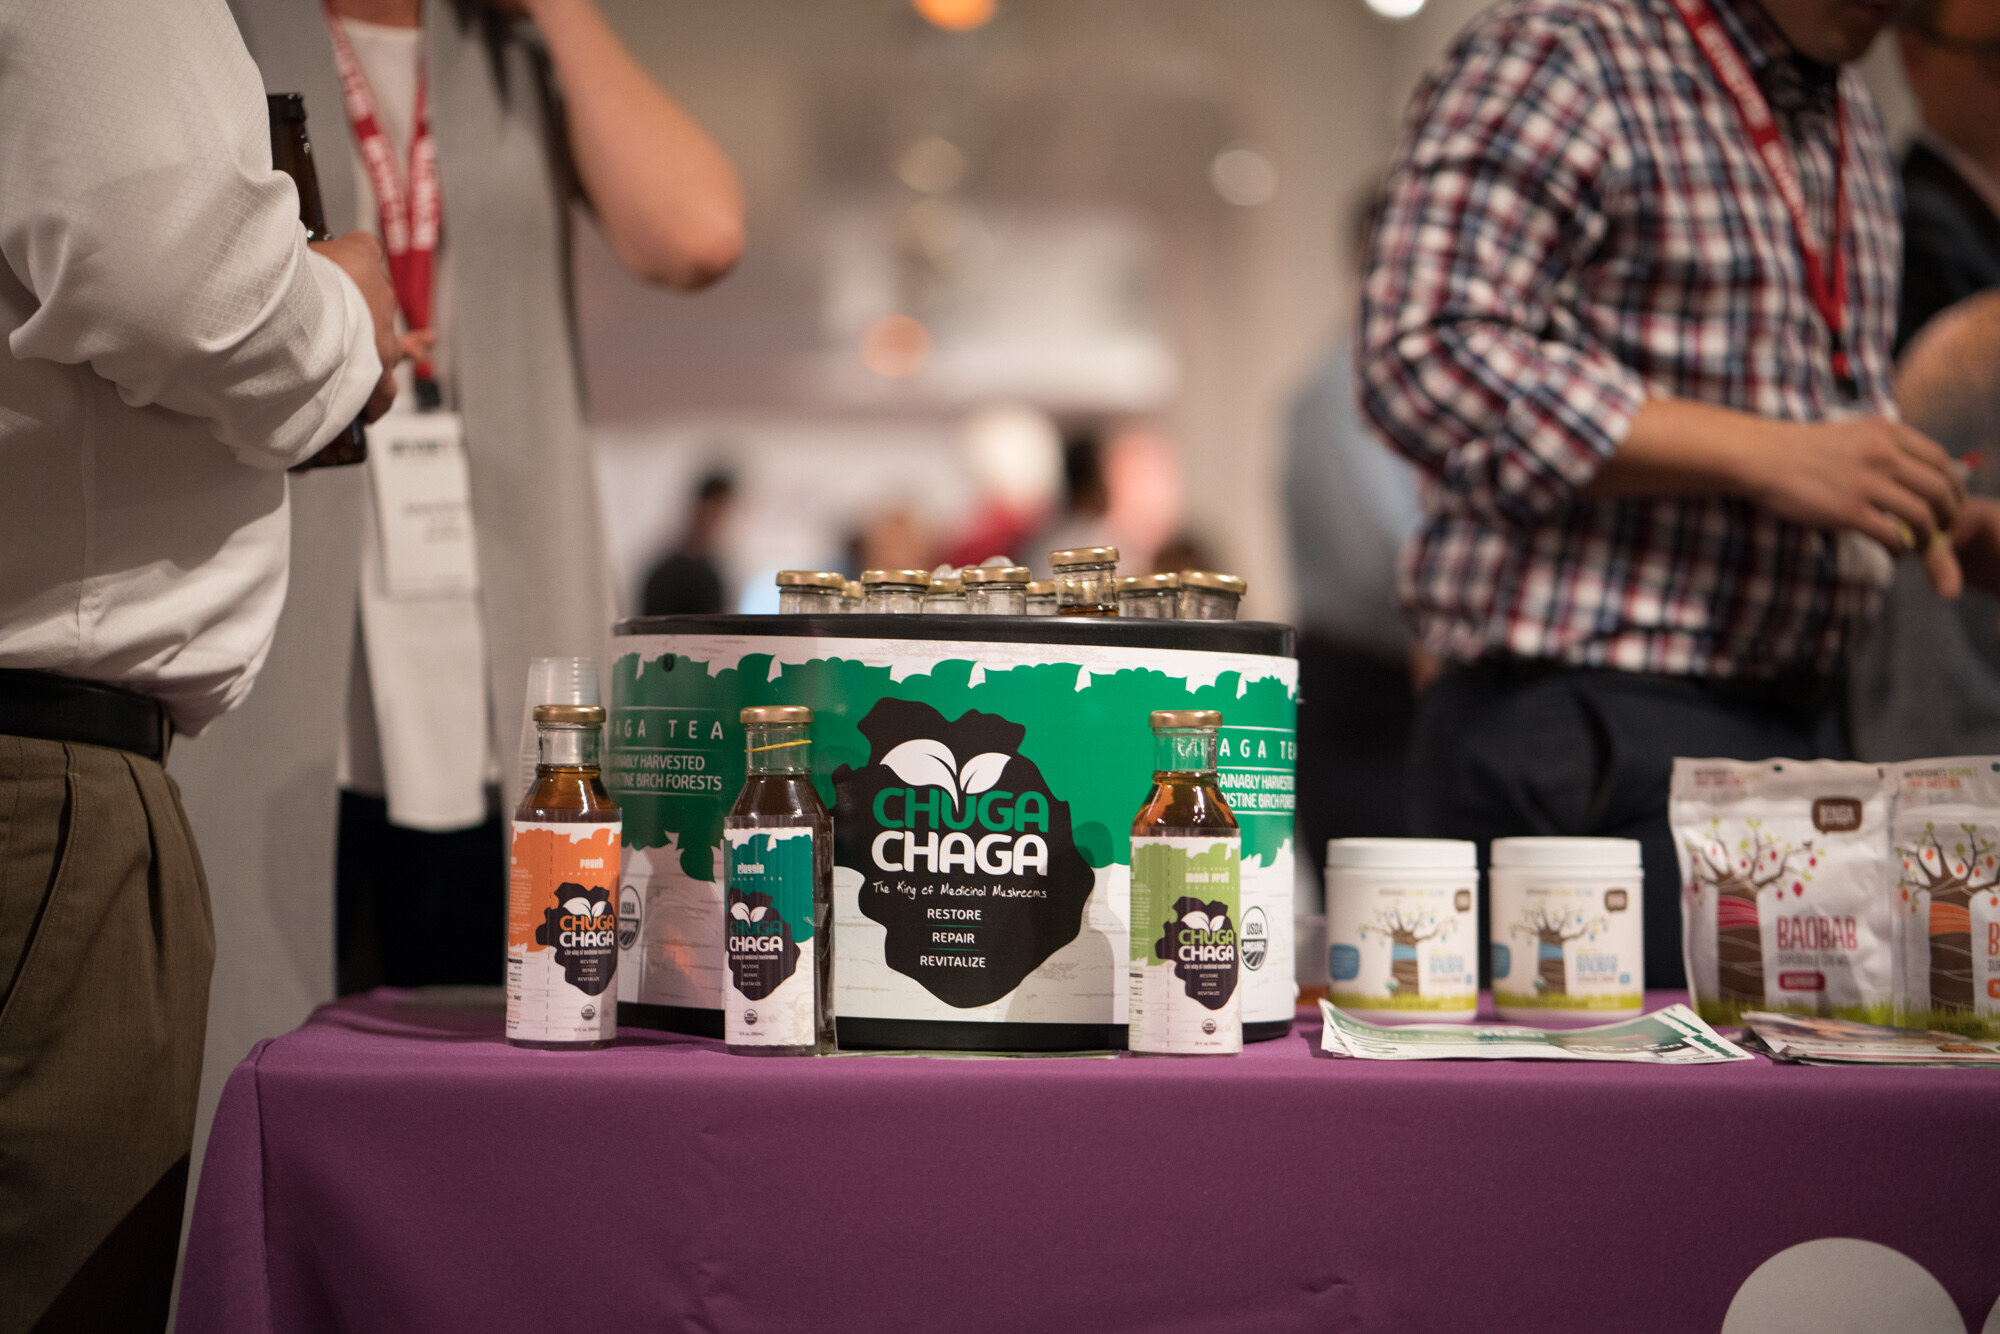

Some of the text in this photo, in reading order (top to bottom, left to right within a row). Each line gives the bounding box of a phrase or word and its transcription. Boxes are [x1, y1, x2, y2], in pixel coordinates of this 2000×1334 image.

[615, 719, 723, 740] AGA TEA
[1219, 738, 1267, 759] AGA
[640, 754, 705, 771] HARVESTED
[636, 773, 664, 788] BIRCH
[666, 774, 722, 791] FORESTS
[872, 787, 1049, 832] CHUGA
[871, 830, 1048, 876] CHAGA
[873, 880, 1047, 900] The King of Medicinal Mushrooms
[559, 914, 615, 931] CHUGA
[927, 908, 982, 921] RESTORE
[730, 920, 783, 936] CHUGA
[1246, 923, 1263, 936] USDA
[1777, 916, 1858, 950] BAOBAB
[559, 930, 614, 947] CHAGA
[729, 936, 783, 952] CHAGA
[932, 932, 975, 944] REPAIR
[1178, 929, 1234, 945] CHUGA
[920, 955, 986, 968] REVITALIZE
[1178, 945, 1234, 961] CHAGA
